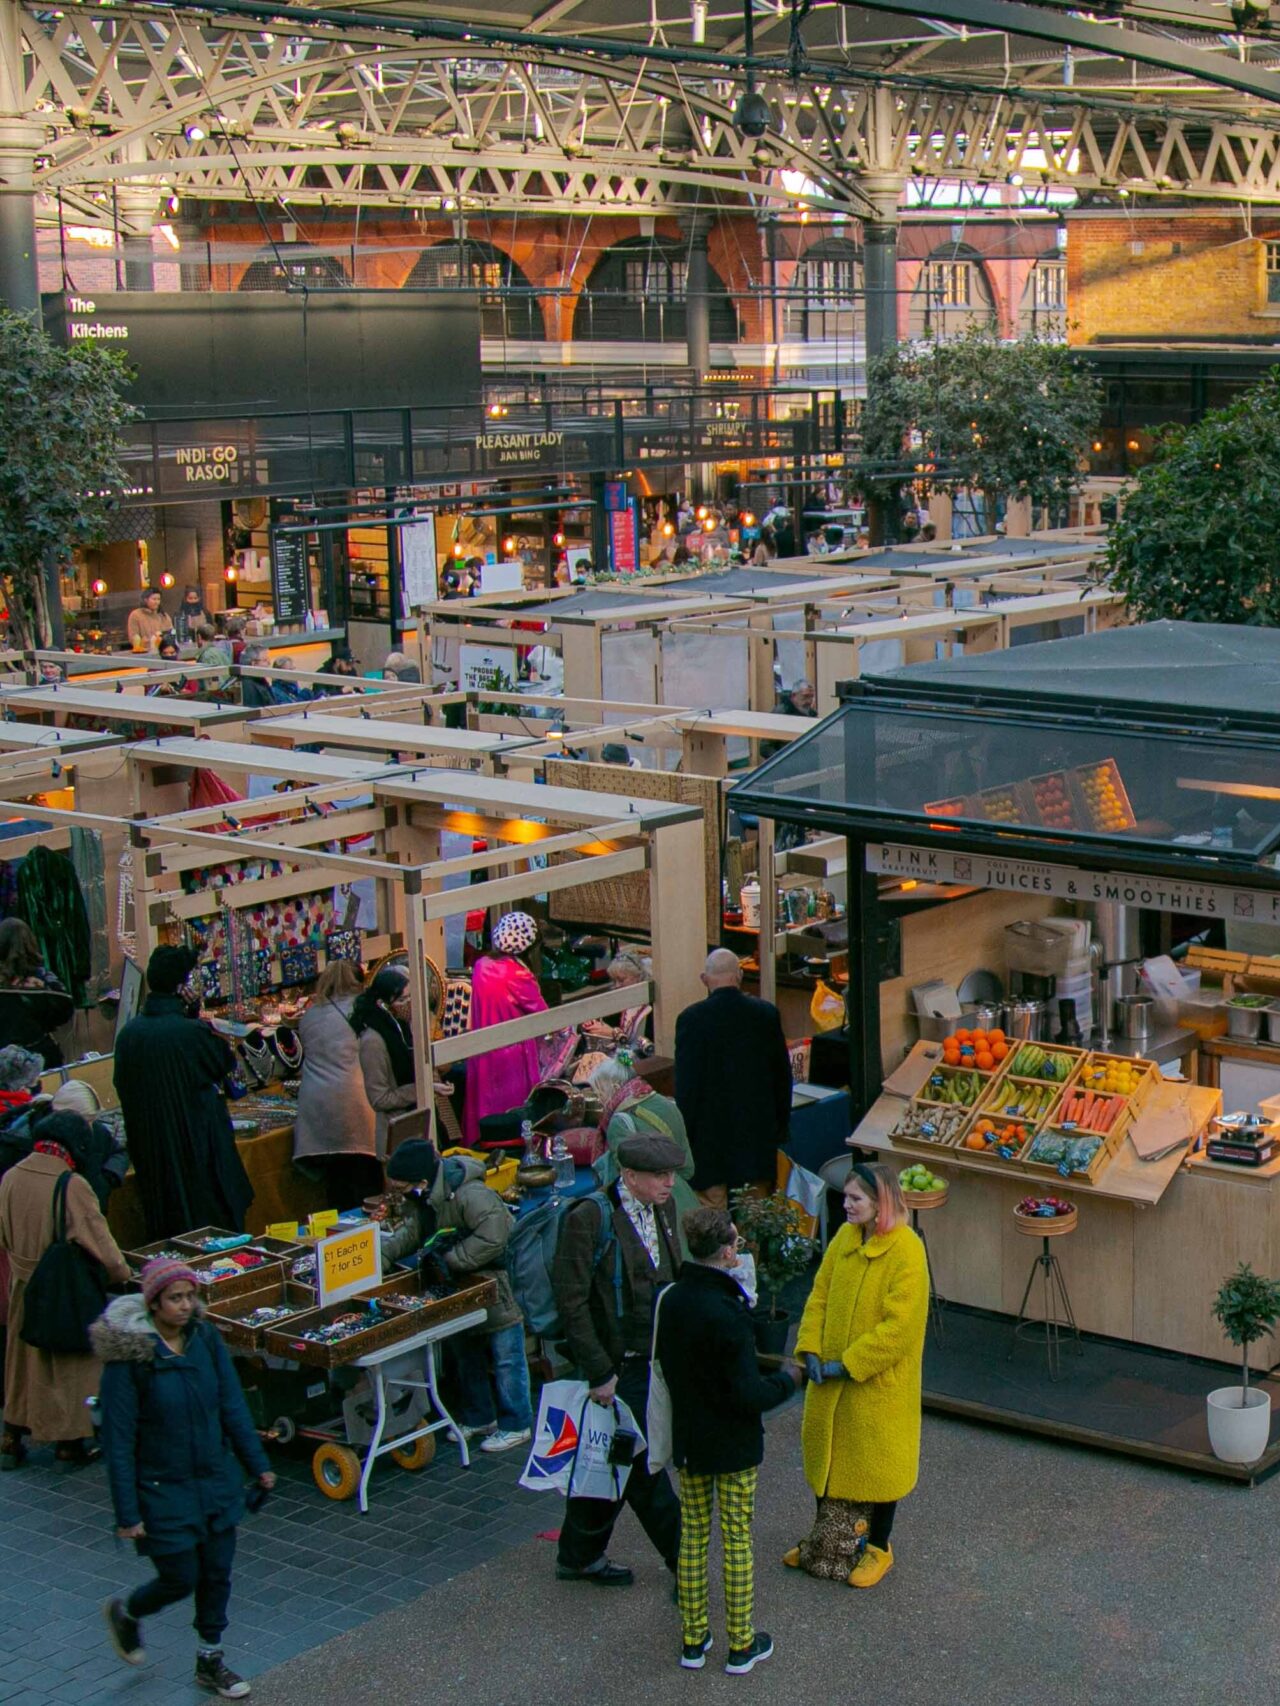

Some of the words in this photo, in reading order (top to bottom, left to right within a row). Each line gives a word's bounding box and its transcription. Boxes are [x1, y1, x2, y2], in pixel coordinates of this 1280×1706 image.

[70, 298, 96, 313] The
[71, 323, 129, 338] Kitchens
[706, 421, 746, 436] SHRIMPY
[475, 434, 531, 449] PLEASANT
[533, 431, 564, 446] LADY
[499, 450, 518, 461] JIAN
[185, 464, 230, 482] RASOI
[882, 847, 938, 868] PINK
[986, 870, 1053, 891] JUICES
[1067, 880, 1078, 895] &
[1093, 883, 1217, 913] SMOOTHIES
[324, 1251, 334, 1263] £1
[336, 1242, 358, 1258] Each
[359, 1240, 369, 1249] or
[338, 1260, 351, 1272] for
[352, 1254, 364, 1267] £5
